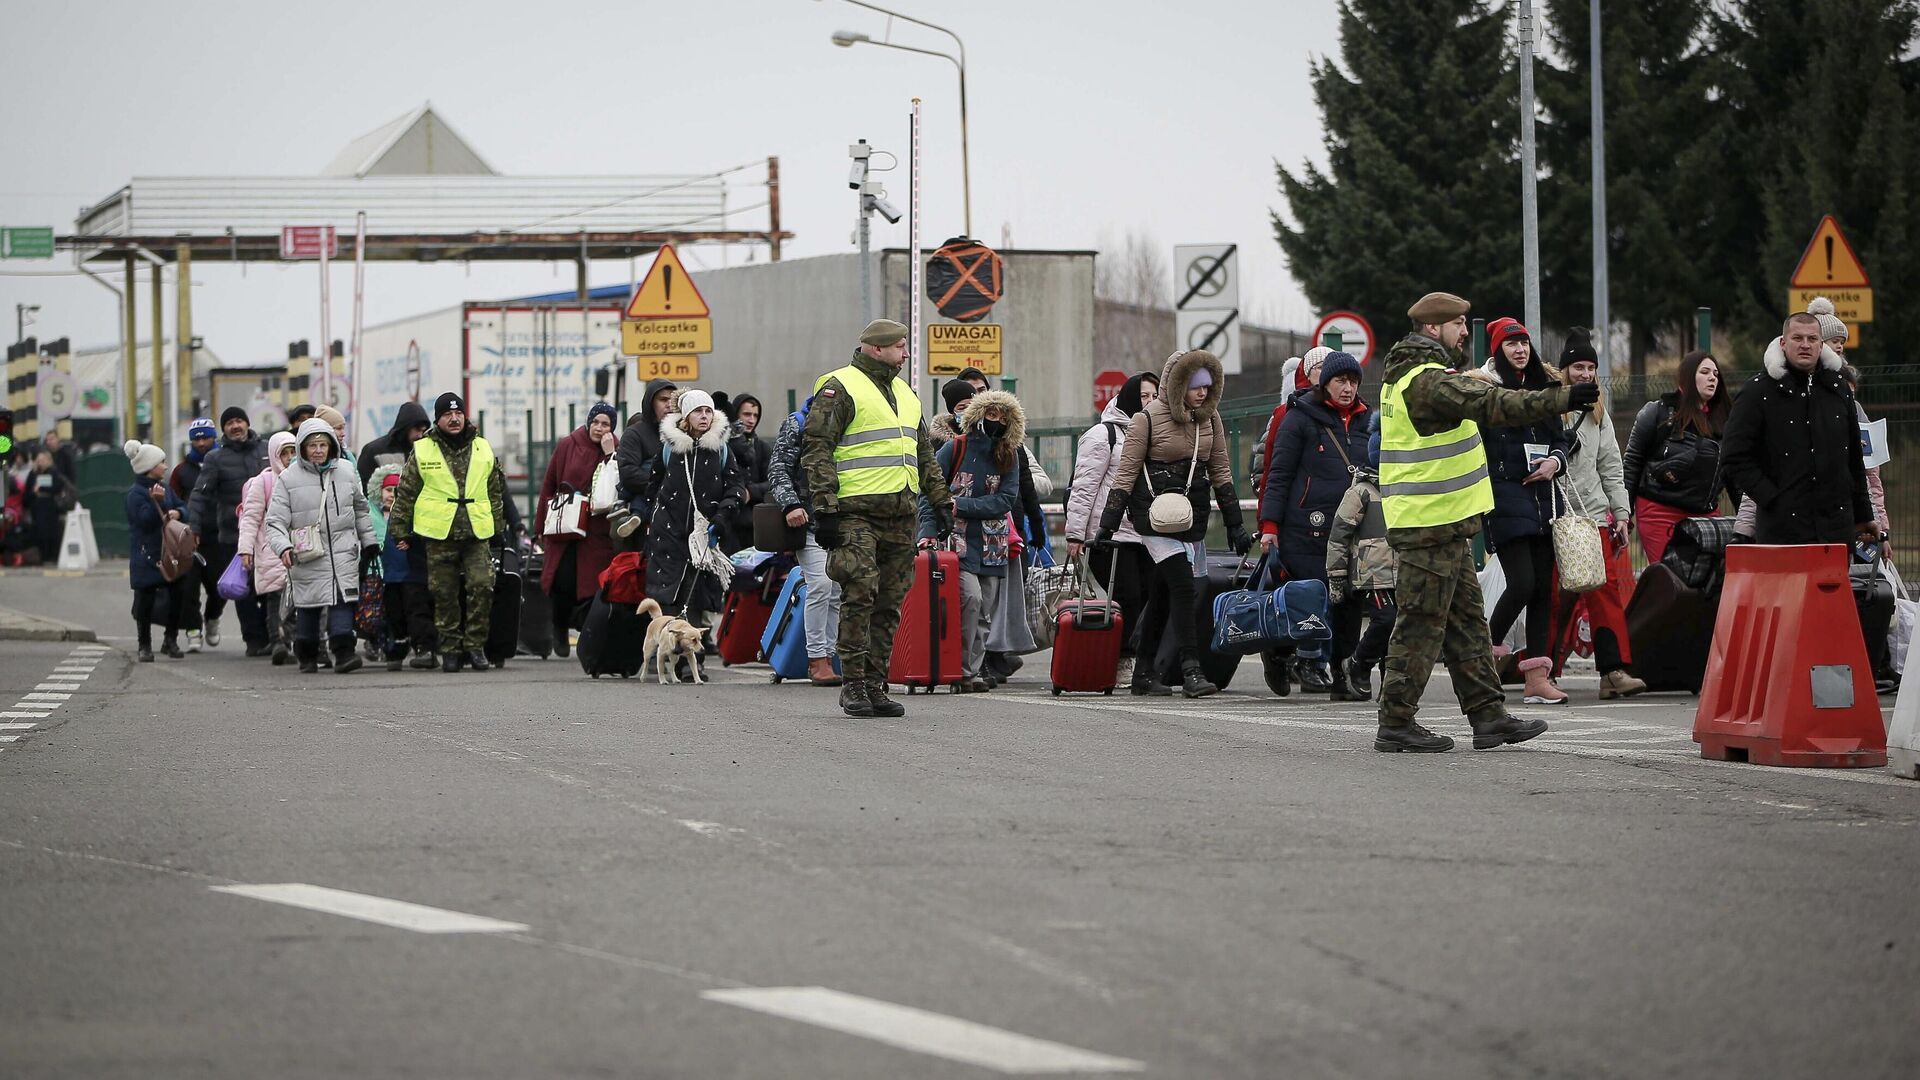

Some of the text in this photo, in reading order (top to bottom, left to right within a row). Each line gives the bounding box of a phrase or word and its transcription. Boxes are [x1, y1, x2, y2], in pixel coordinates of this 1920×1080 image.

[634, 322, 698, 334] Kolczatka
[933, 327, 996, 339] UWAGA!
[638, 340, 695, 353] drogowa
[649, 361, 689, 375] 30 m
[51, 384, 64, 405] 5
[330, 385, 340, 407] 5
[1093, 384, 1123, 402] STO
